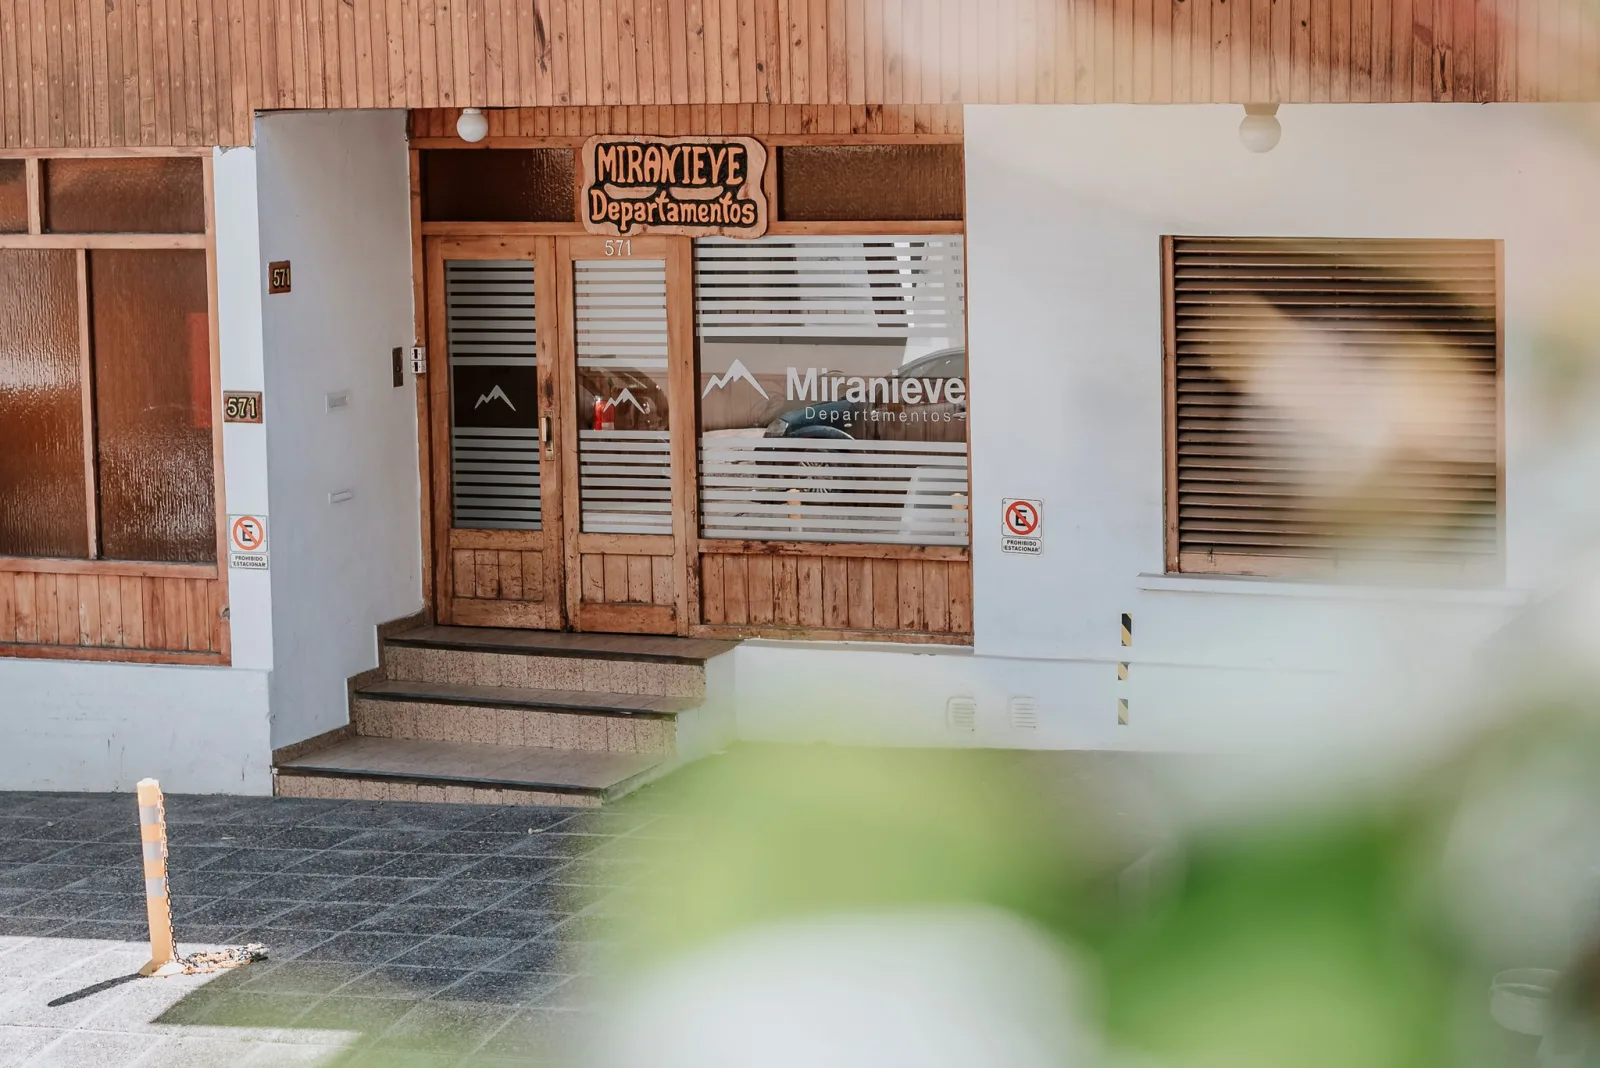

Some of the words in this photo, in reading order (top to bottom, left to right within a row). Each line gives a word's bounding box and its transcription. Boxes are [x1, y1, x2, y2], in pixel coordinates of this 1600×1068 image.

[597, 145, 744, 185] MIRANIEVE
[590, 189, 756, 231] Departamentos
[604, 239, 632, 256] 571
[273, 268, 290, 287] 571
[786, 366, 966, 404] Miranieve
[227, 397, 257, 418] 571
[805, 406, 951, 423] Departamentos
[1006, 539, 1037, 547] PROHIBIDO
